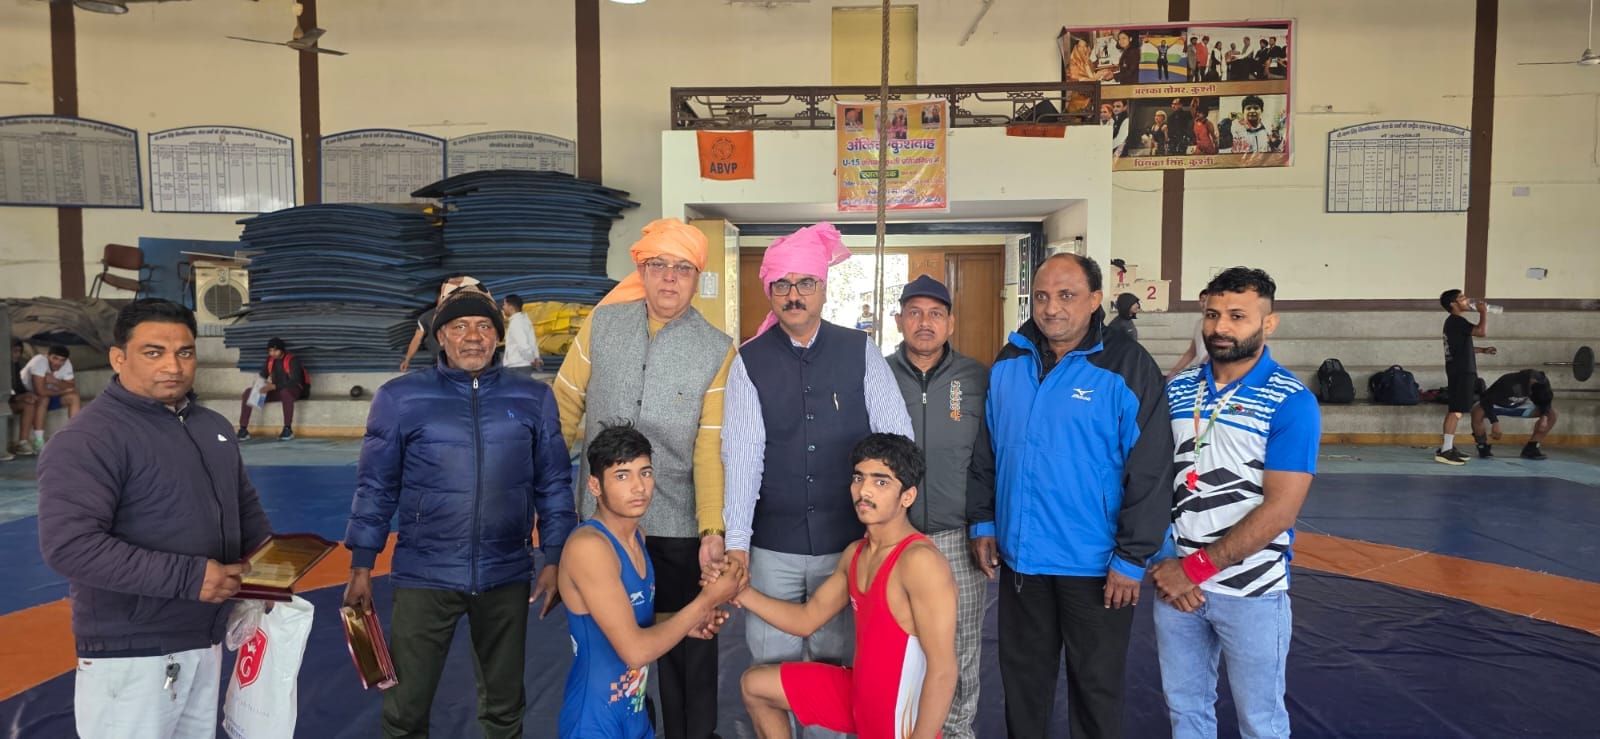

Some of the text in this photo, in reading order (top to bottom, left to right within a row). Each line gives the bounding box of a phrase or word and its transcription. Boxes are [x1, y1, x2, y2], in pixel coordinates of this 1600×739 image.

[710, 162, 738, 174] ABVP
[842, 158, 859, 166] U-15
[1146, 286, 1157, 300] 2
